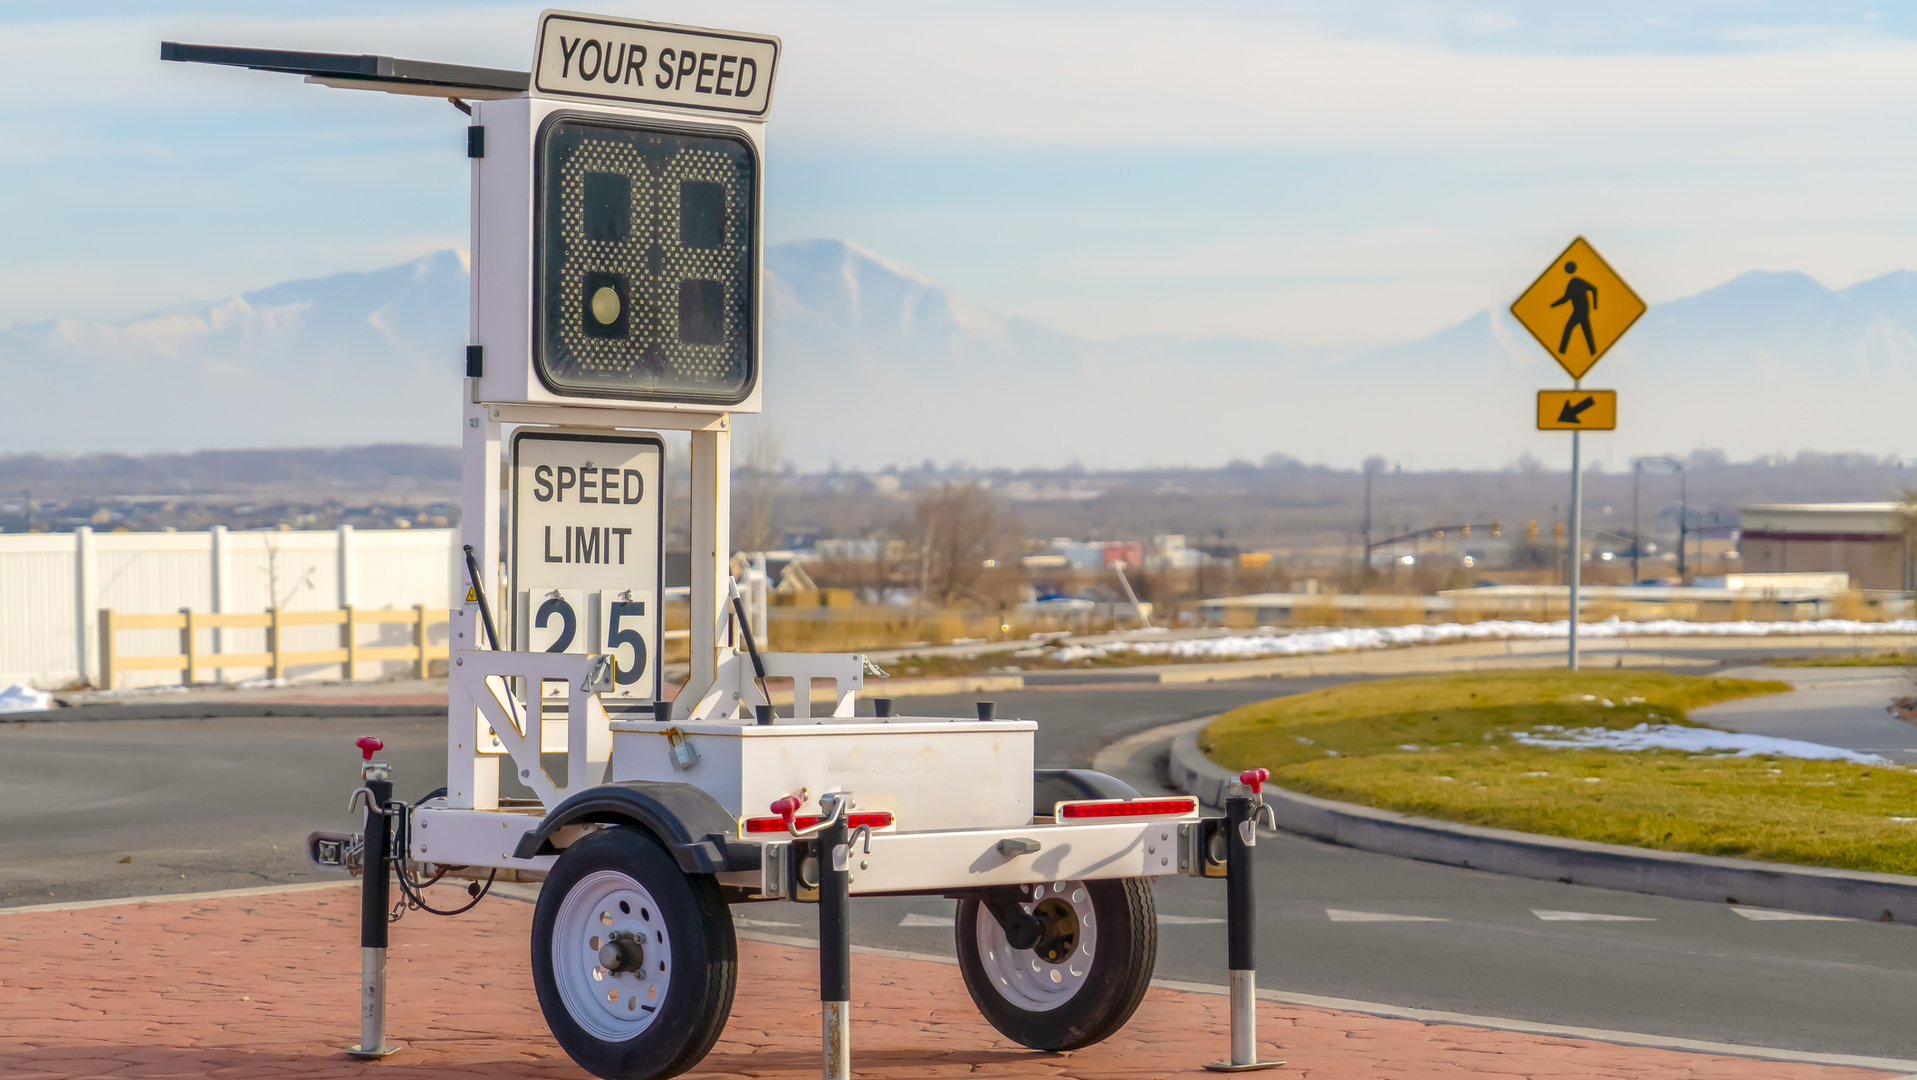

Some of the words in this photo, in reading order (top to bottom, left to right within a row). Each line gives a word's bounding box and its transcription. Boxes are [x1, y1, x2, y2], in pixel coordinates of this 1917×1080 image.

[559, 35, 648, 87] YOUR
[655, 47, 758, 98] SPEED
[533, 464, 644, 505] SPEED
[544, 525, 632, 565] LIMIT
